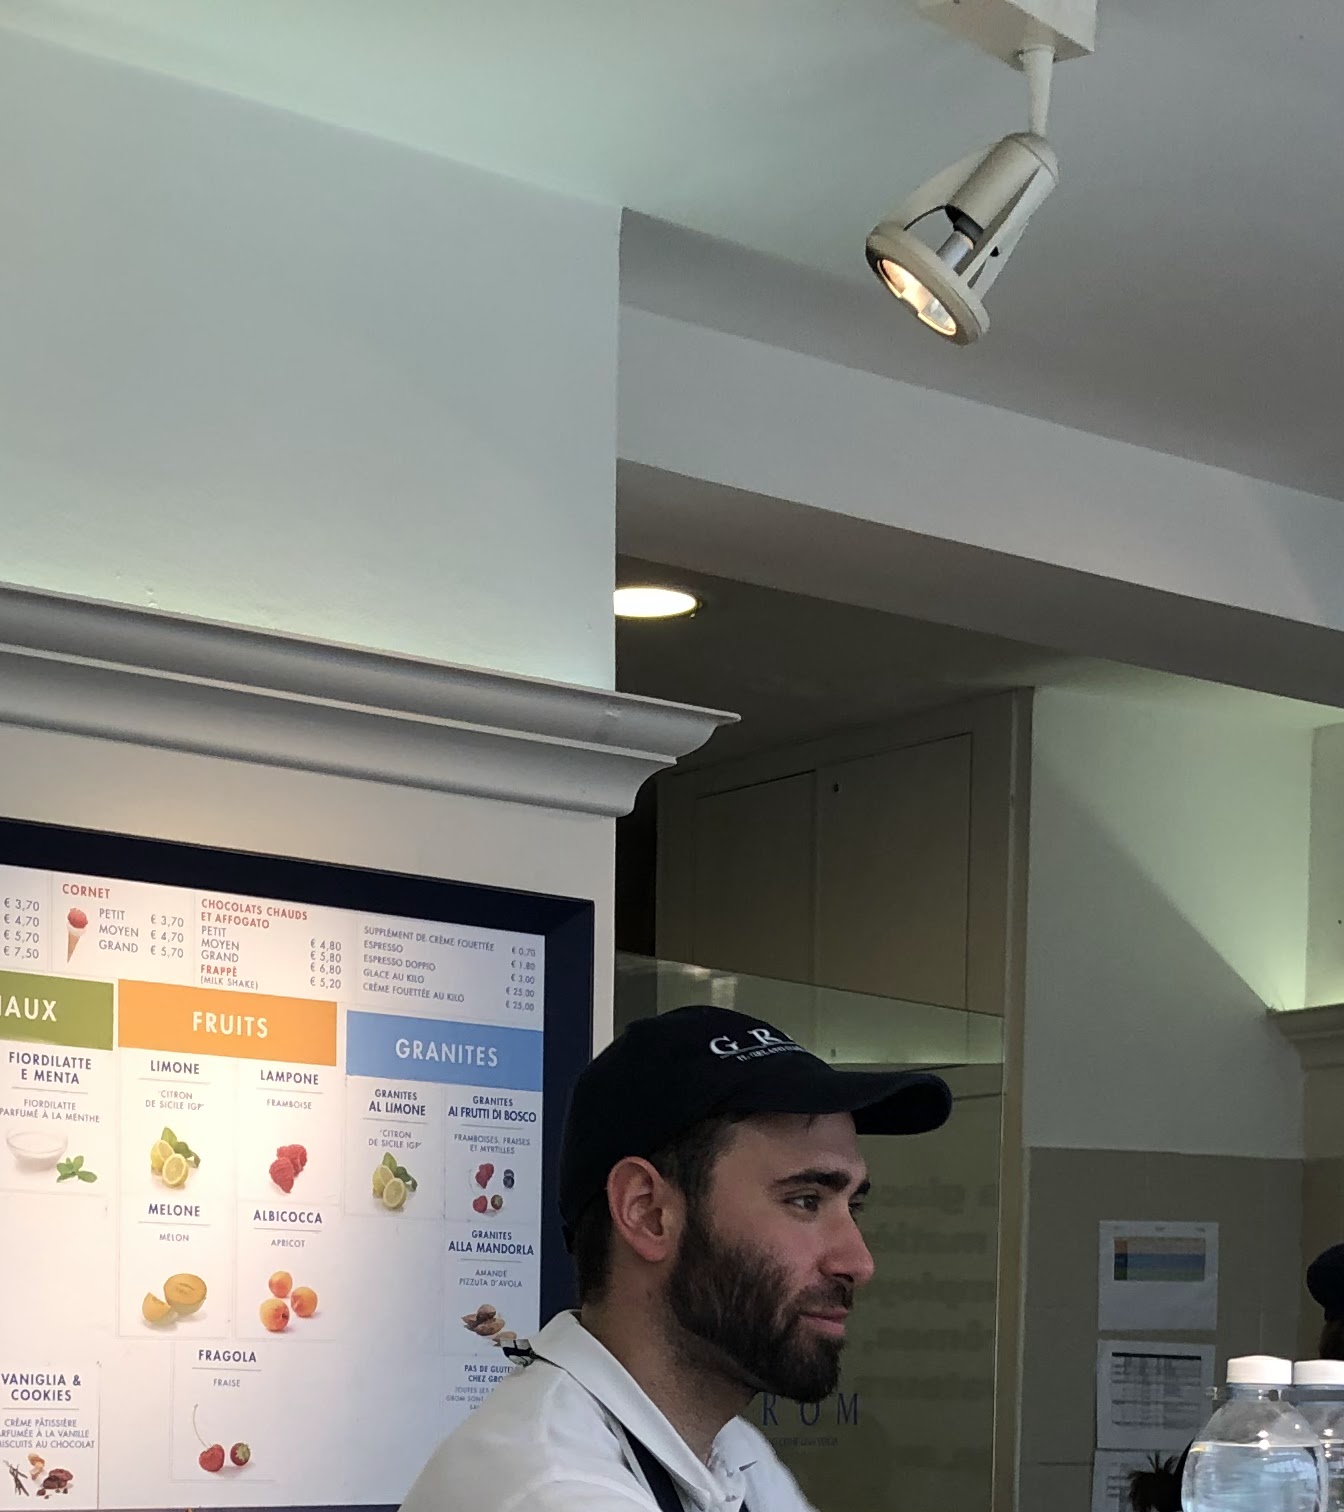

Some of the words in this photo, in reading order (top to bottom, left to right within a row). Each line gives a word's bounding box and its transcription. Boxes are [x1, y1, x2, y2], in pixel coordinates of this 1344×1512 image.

[62, 883, 111, 899] CORNET
[4, 897, 11, 908] €
[15, 898, 40, 912] 3,70
[201, 898, 262, 915] CHOCOLATS
[266, 907, 308, 920] CHAUDS
[4, 913, 11, 924] €
[14, 914, 40, 928] 4,70
[99, 907, 125, 921] PETIT
[150, 914, 157, 925] €
[161, 915, 184, 929] 3,70
[201, 912, 212, 921] ET
[215, 914, 270, 929] AFFOGATO
[4, 929, 10, 940] €
[14, 930, 40, 944] 5,70
[99, 924, 139, 938] MOYEN
[150, 929, 157, 940] €
[161, 931, 184, 943] 4,70
[201, 925, 226, 937] PETIT
[98, 939, 139, 953] GRAND
[150, 945, 157, 955] €
[161, 946, 184, 959] 5,70
[201, 938, 239, 951] MOYEN
[4, 945, 10, 957] €
[14, 946, 40, 960] 7,50
[201, 950, 239, 963] GRAND
[201, 976, 224, 986] (MILK
[227, 978, 258, 990] SHAKE)
[192, 1011, 268, 1039] FRUITS
[9, 1051, 92, 1070] FIORDILATTE
[395, 1038, 498, 1068] GRANITES
[150, 1060, 200, 1075] LIMONE
[21, 1068, 28, 1080] E
[34, 1069, 80, 1085] MENTA
[260, 1069, 319, 1085] LAMPONE
[374, 1088, 418, 1101] GRANITES
[472, 1096, 513, 1107] GRANITES
[266, 1098, 312, 1110] FRAMBOISE
[369, 1101, 382, 1113] AL
[385, 1102, 426, 1116] LIMONE
[448, 1106, 458, 1117] AI
[460, 1108, 490, 1120] FRUTTI
[492, 1109, 502, 1120] DI
[504, 1110, 537, 1123] BOSCO
[148, 1203, 201, 1218] MELONE
[253, 1209, 323, 1224] ALBICOCCA
[471, 1229, 512, 1241] GRANITES
[271, 1239, 305, 1248] APRICOT
[448, 1240, 473, 1253] ALLA
[476, 1242, 534, 1256] MANDORLA
[198, 1349, 257, 1363] FRAGOLA
[1, 1373, 67, 1386] VANIGLIA
[72, 1374, 82, 1386] &
[213, 1378, 241, 1388] FRAISE
[11, 1389, 72, 1402] COOKIES
